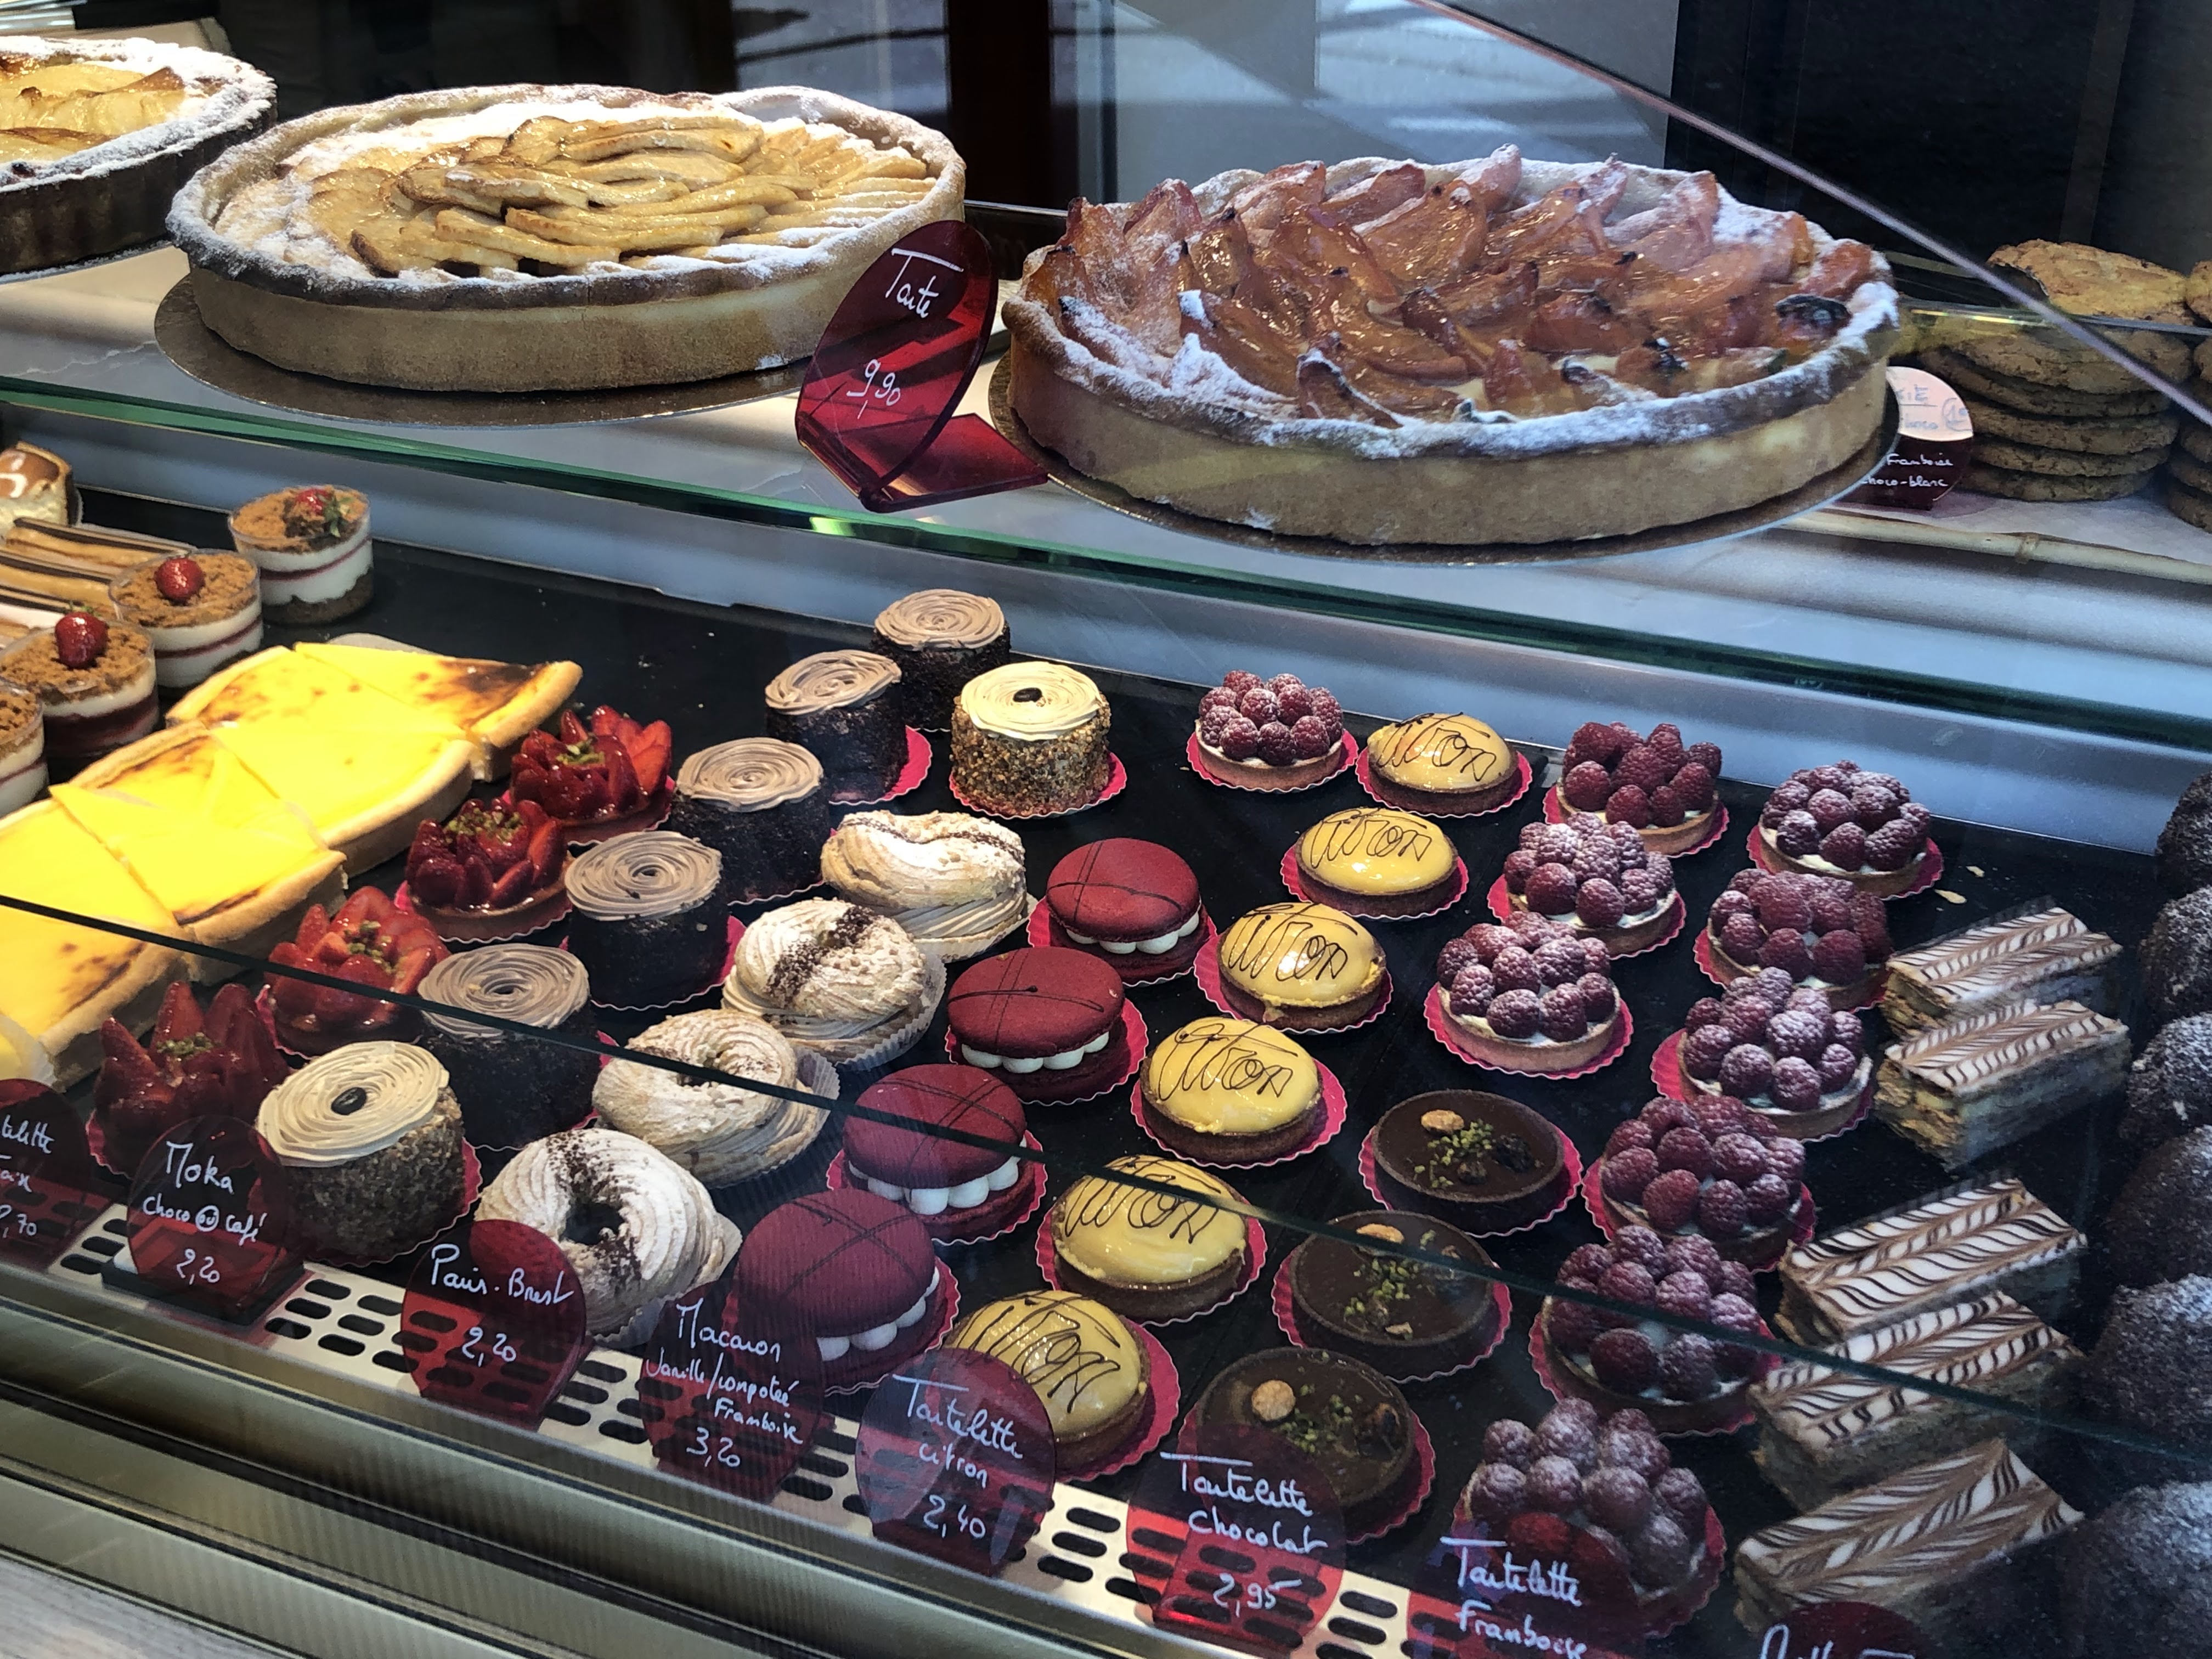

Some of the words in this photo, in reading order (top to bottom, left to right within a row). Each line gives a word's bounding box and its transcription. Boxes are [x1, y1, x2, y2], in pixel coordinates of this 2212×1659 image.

[885, 247, 964, 318] Tarte
[176, 1249, 220, 1285] 2,20
[462, 1327, 516, 1367] 2,20
[686, 1427, 741, 1467] 3,20
[923, 1494, 986, 1538] 2,40
